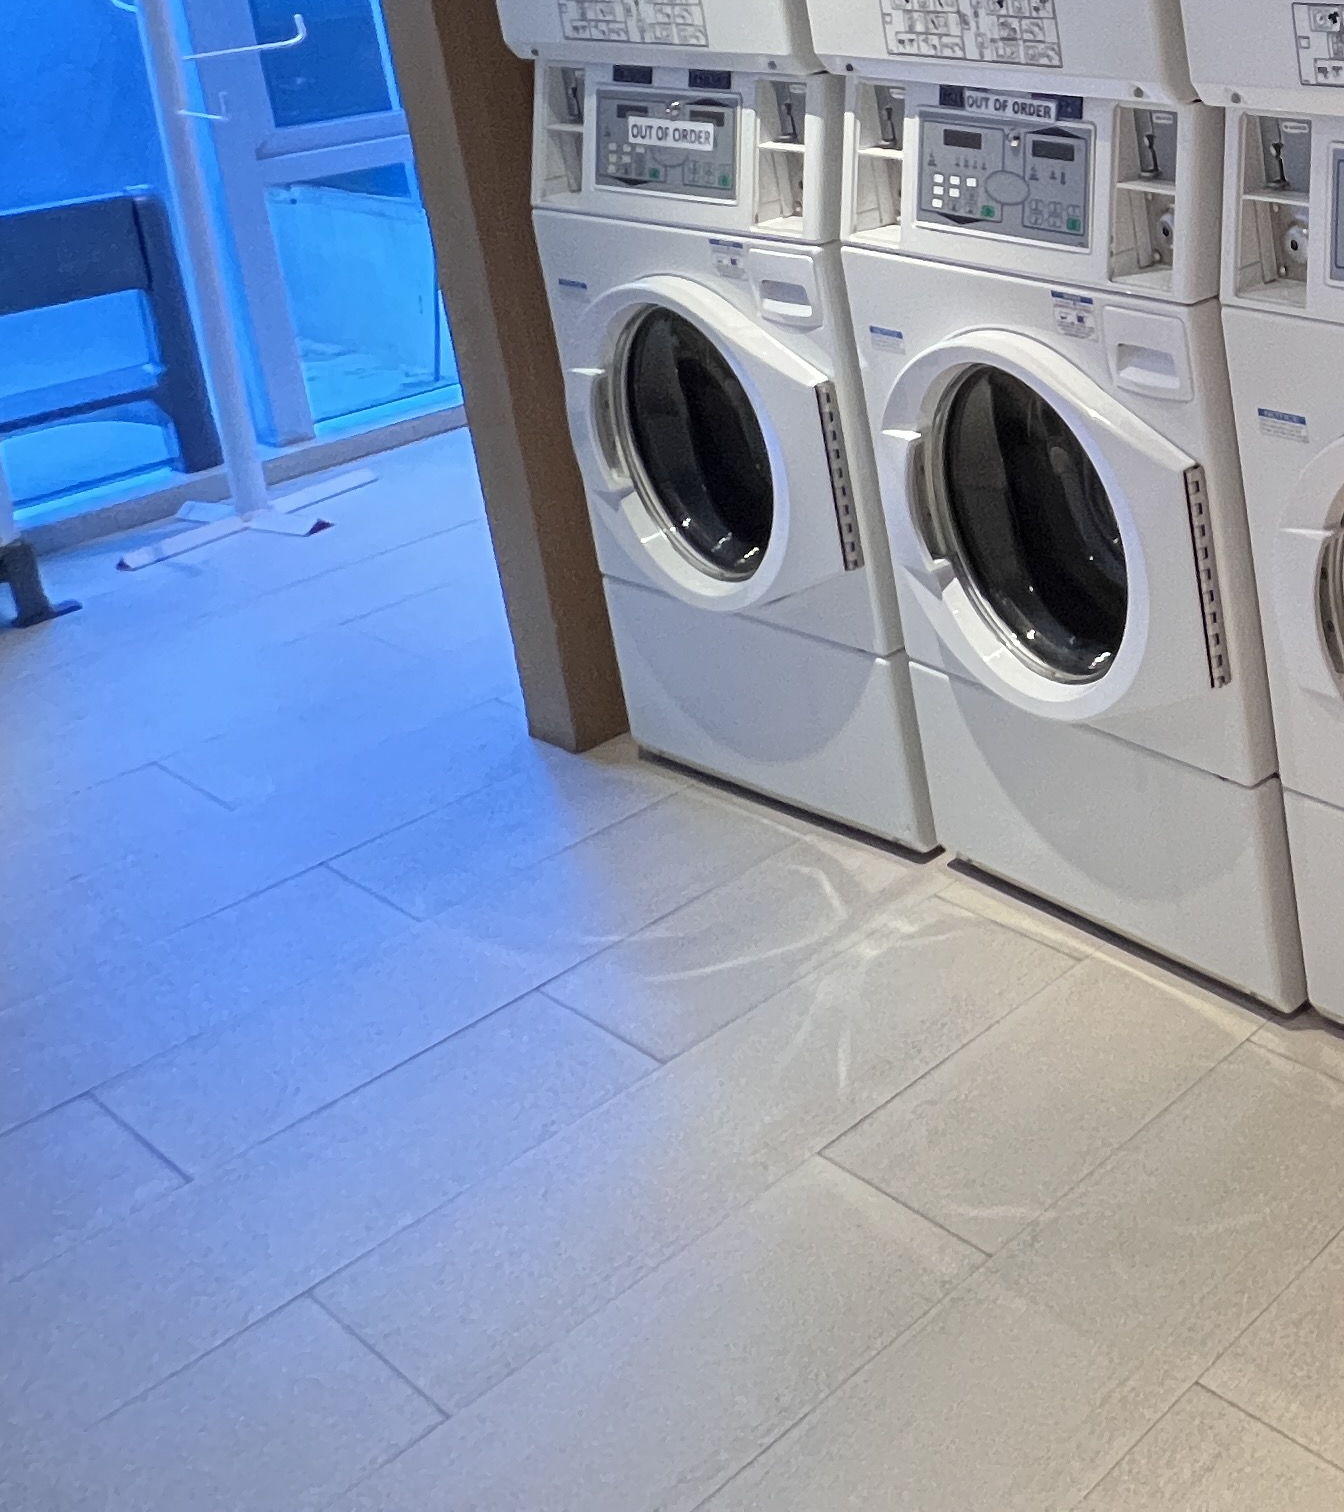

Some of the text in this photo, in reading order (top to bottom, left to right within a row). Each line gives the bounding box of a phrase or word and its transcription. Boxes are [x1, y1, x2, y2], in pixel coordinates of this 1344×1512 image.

[967, 94, 990, 110] OUT
[994, 98, 1009, 113] OF
[1012, 100, 1052, 119] ORDER
[631, 123, 711, 145] OUT OF ORDER
